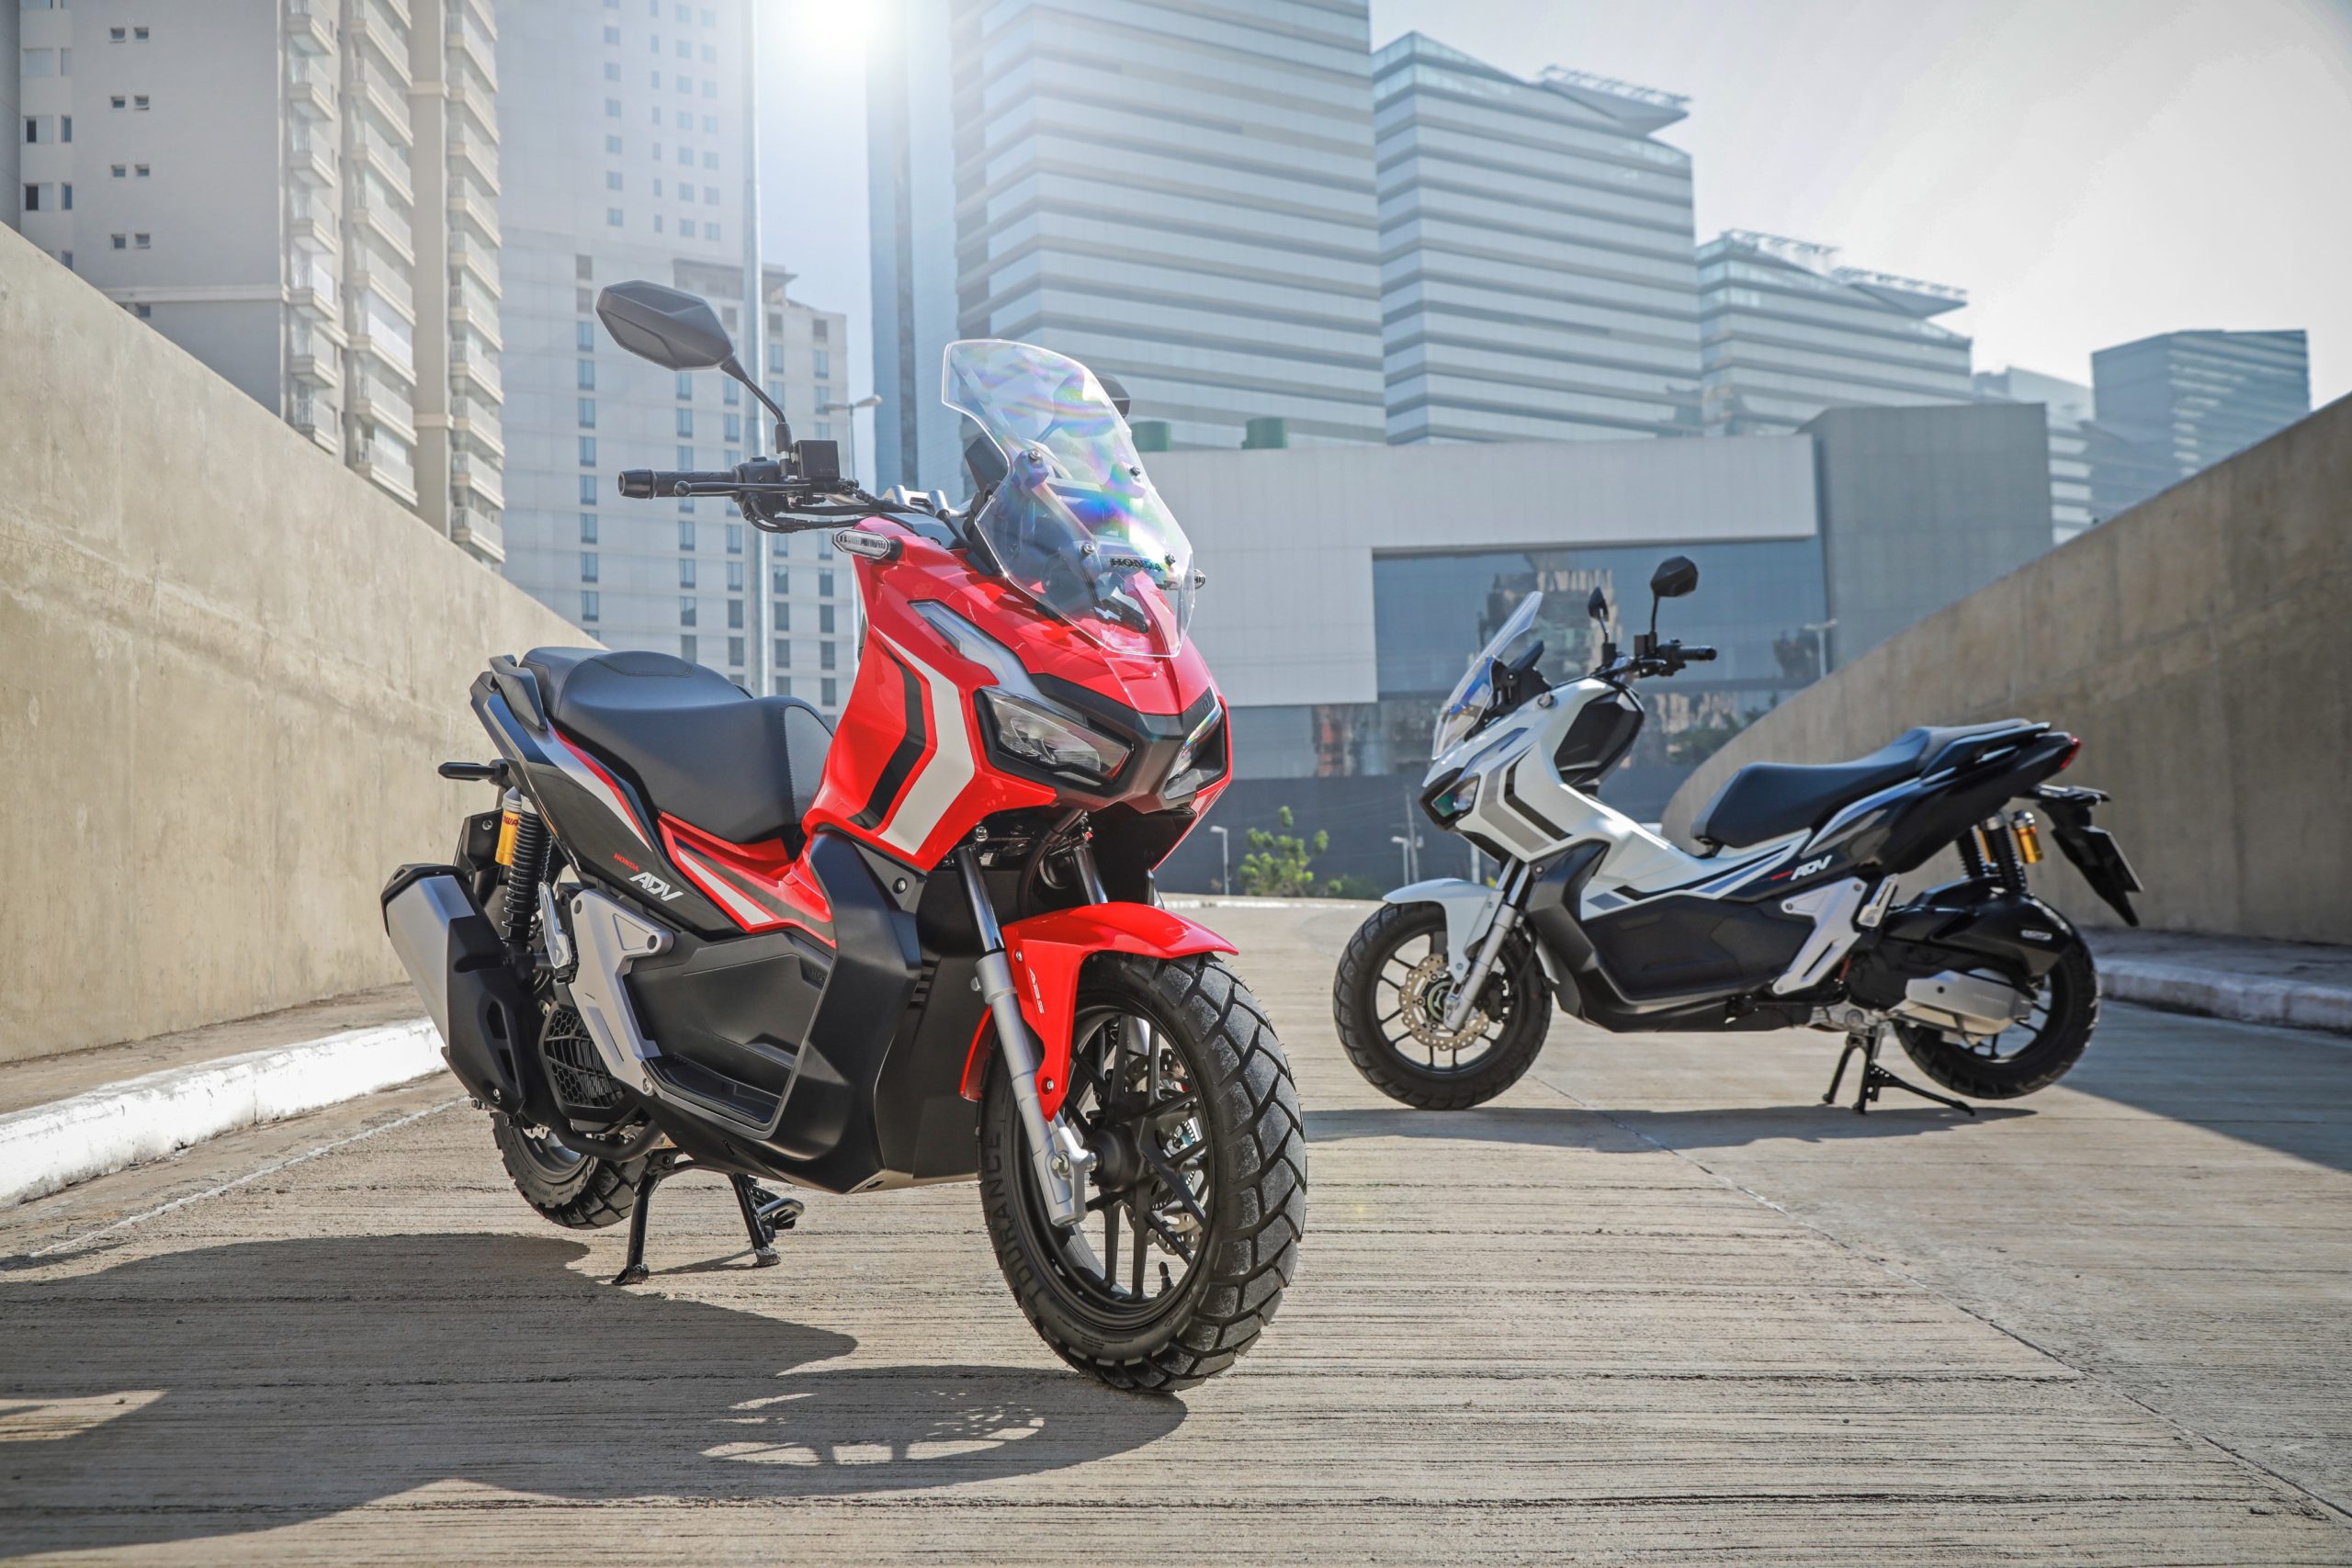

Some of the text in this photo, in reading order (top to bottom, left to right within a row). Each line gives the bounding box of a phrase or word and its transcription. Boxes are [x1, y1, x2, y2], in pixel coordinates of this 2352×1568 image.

[1110, 558, 1163, 572] HONDA
[613, 852, 640, 872] HONDA
[1791, 854, 1833, 880] ADV
[629, 872, 684, 901] ADV
[1029, 967, 1045, 1014] ABS
[986, 1132, 1046, 1307] TOURANCE
